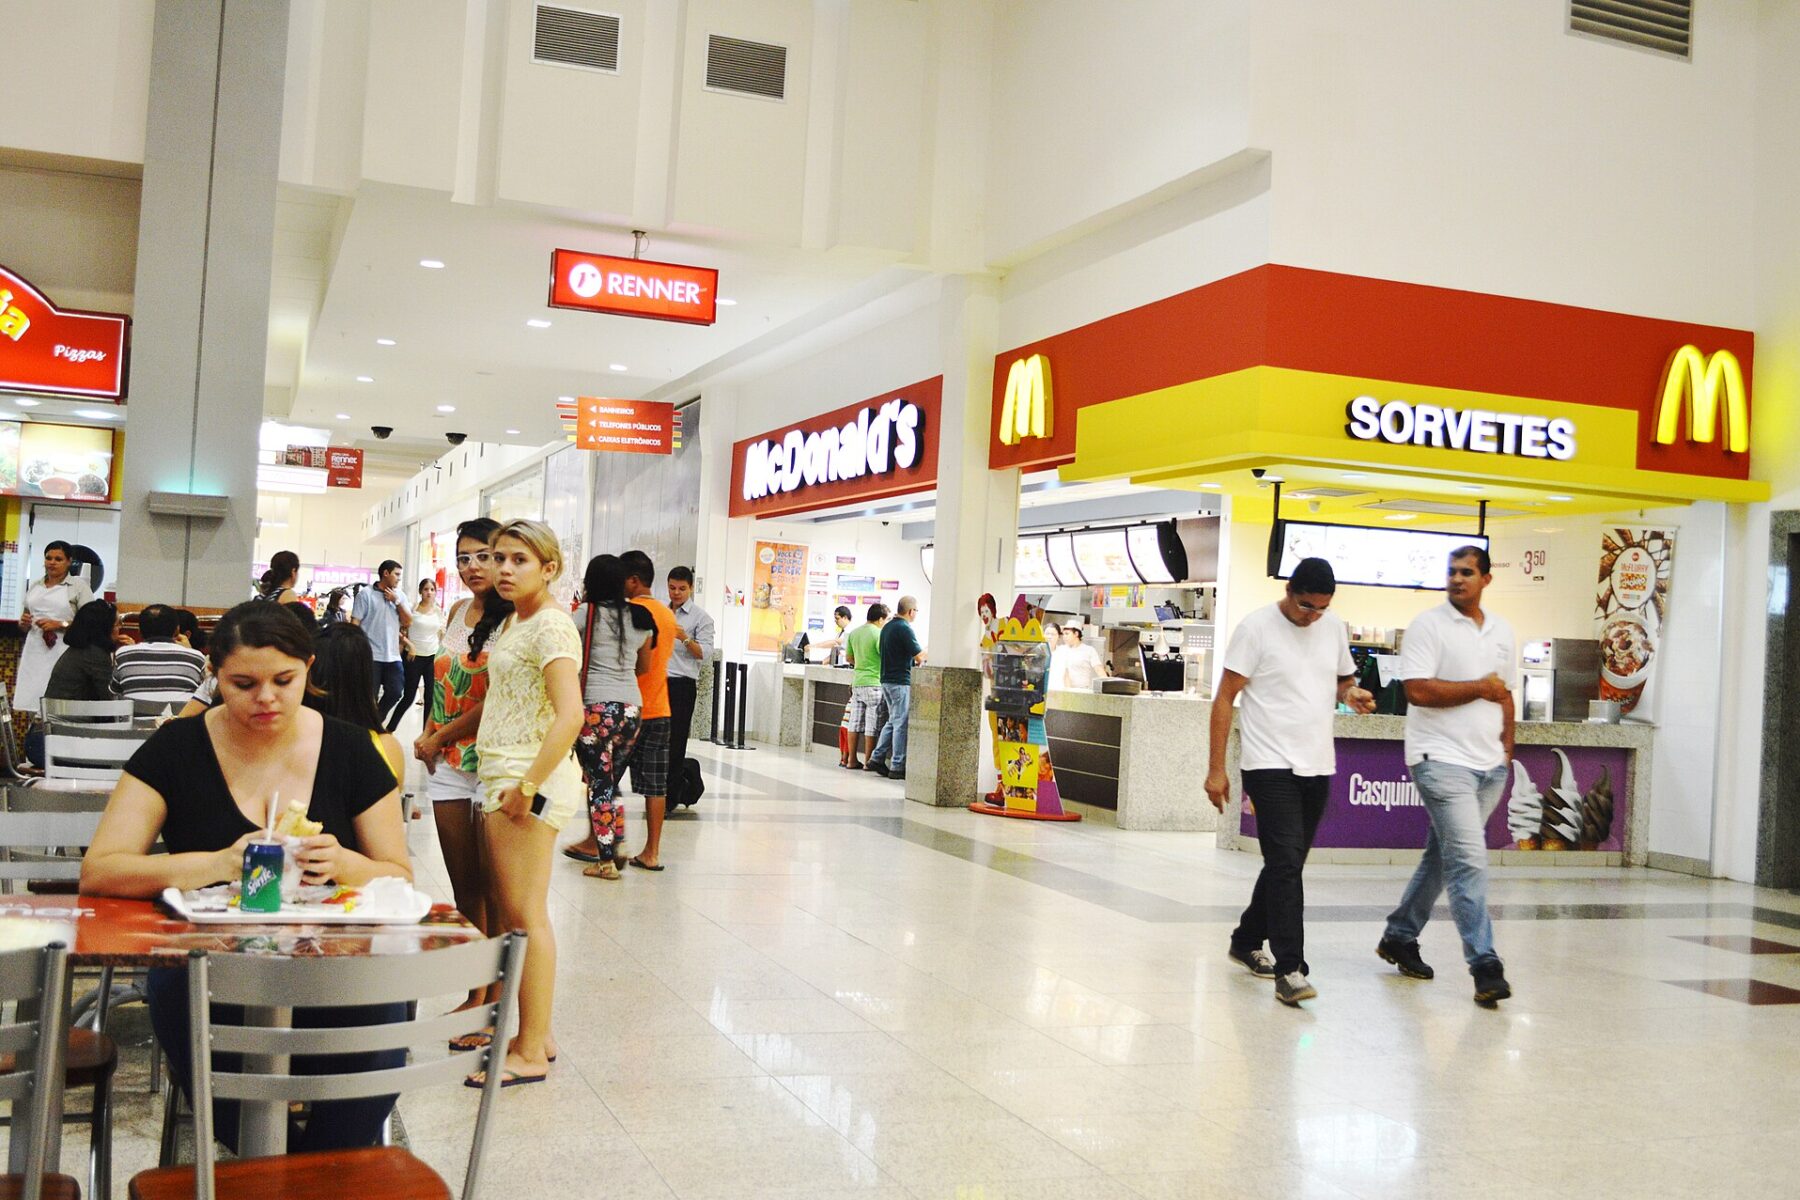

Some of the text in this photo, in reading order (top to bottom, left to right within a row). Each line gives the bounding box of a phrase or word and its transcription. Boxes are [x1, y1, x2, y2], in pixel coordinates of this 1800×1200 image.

[607, 272, 701, 305] RENNER
[54, 344, 107, 363] Pizzas
[598, 435, 662, 447] CAIXAS ELETRÔNICOS
[599, 420, 662, 432] TELEFONES PÚBLICOS
[1349, 396, 1576, 461] SORVETES
[743, 398, 920, 501] McDonald's
[247, 867, 273, 897] Sprite
